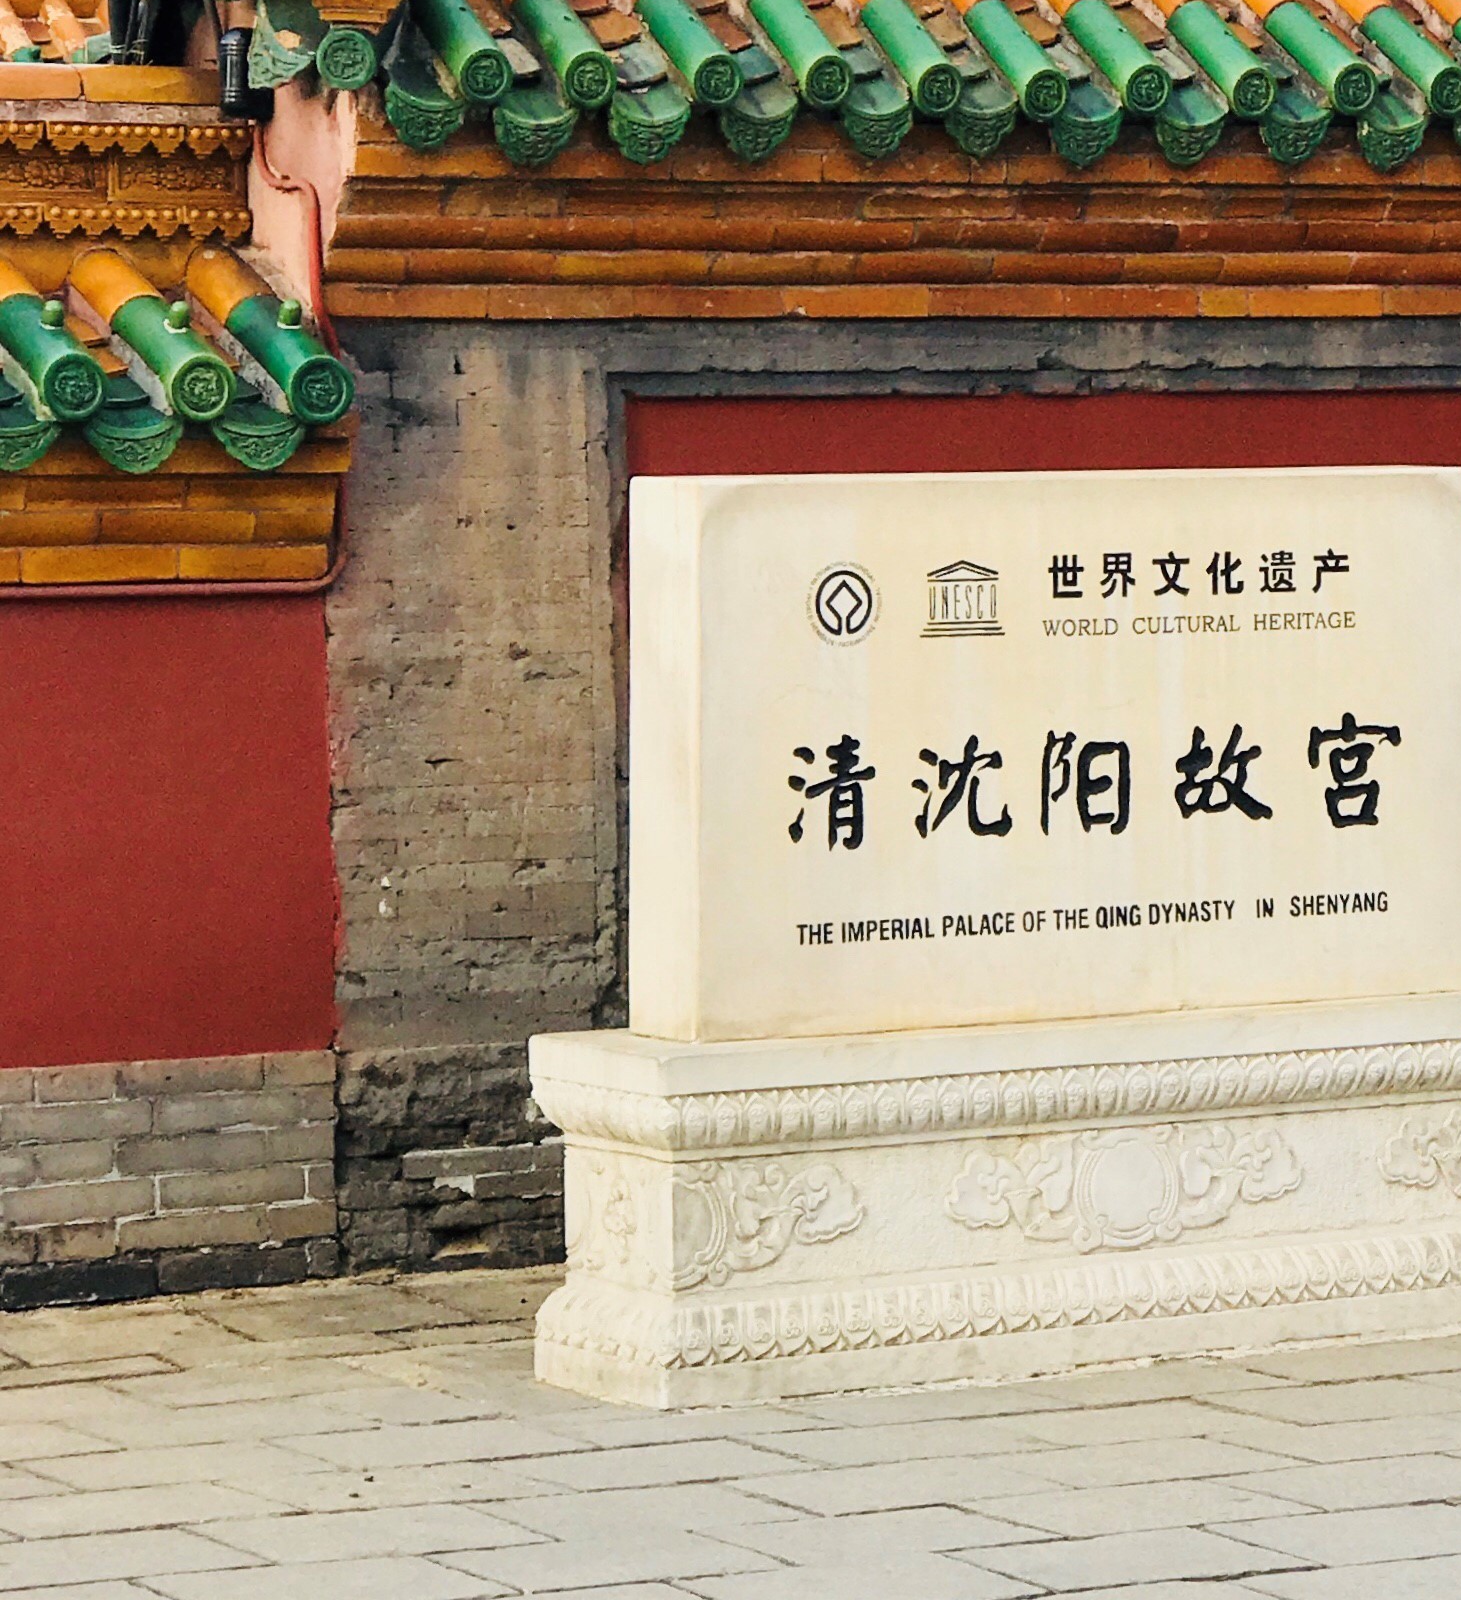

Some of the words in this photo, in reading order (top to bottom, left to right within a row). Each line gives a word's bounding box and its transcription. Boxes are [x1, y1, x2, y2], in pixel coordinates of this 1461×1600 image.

[1047, 548, 1350, 599] 世界文化遗产
[929, 584, 997, 620] UNESCO
[1042, 618, 1119, 637] WORLD
[1132, 614, 1241, 635] CULTURAL
[1253, 611, 1356, 631] HERITAGE
[788, 712, 1402, 851] 清沈阳故宫
[796, 922, 834, 946] THE
[841, 917, 935, 943] IMPERIAL
[942, 912, 1016, 937] PALACE
[1022, 910, 1047, 933] OF
[1053, 908, 1090, 931] THE
[1095, 904, 1142, 929] QING
[1148, 900, 1236, 926] DYNASTY
[1256, 898, 1274, 918] IN
[1289, 891, 1389, 918] SHENYANG
